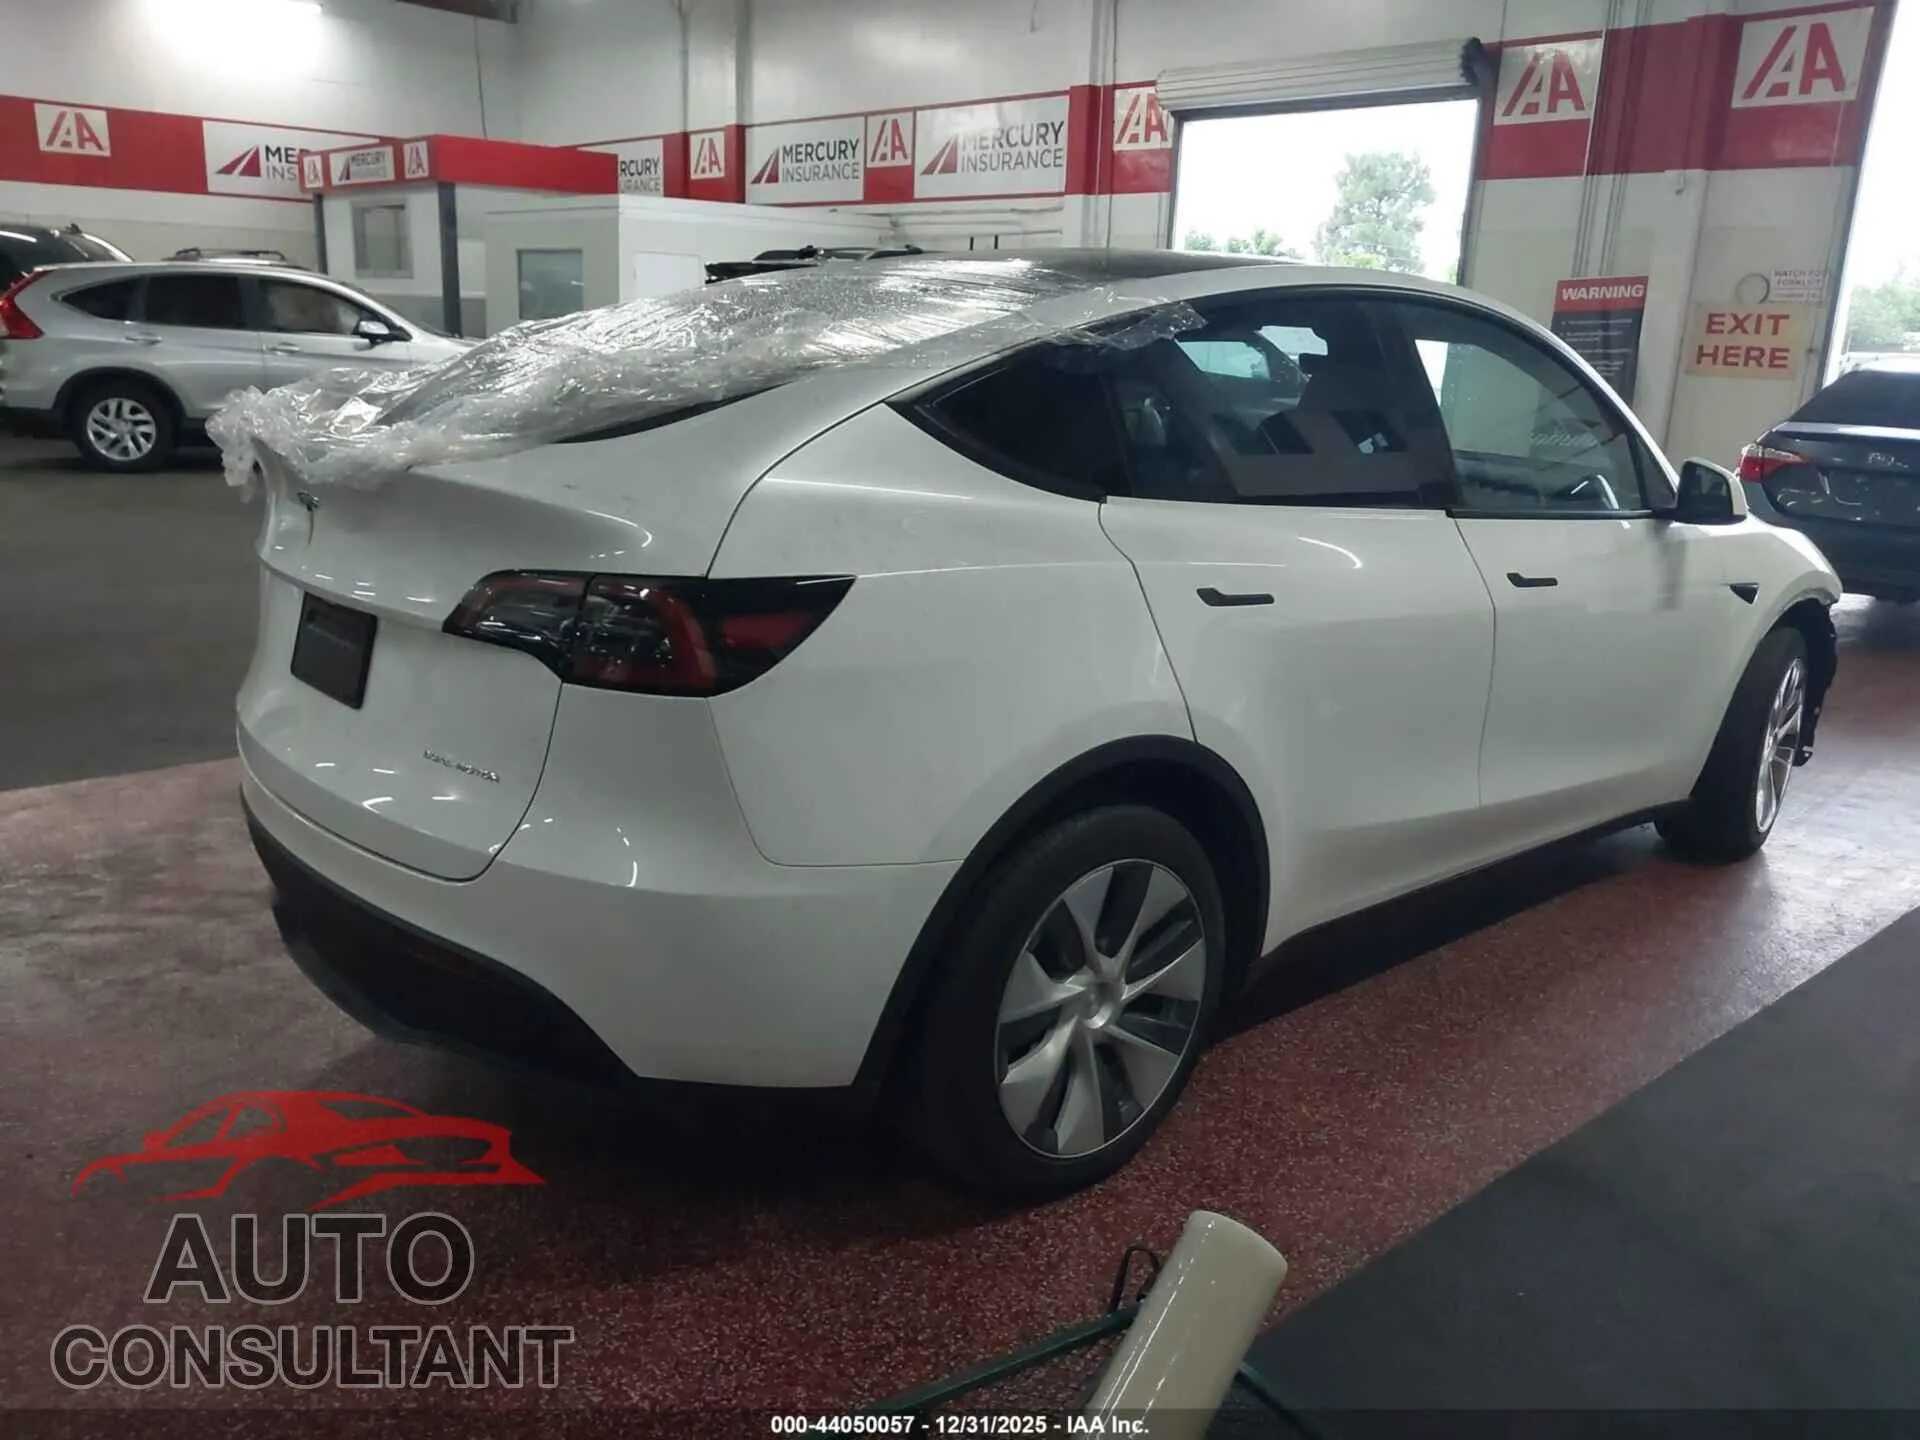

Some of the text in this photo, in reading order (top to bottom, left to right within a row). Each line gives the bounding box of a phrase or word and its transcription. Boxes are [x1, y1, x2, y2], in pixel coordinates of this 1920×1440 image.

[963, 120, 1065, 152] MERCURY
[782, 138, 860, 164] MERCURY
[961, 147, 1064, 174] INSURANCE
[781, 162, 860, 183] INSURANCE
[1562, 284, 1645, 301] WARNING
[1705, 312, 1790, 336] EXIT
[1696, 344, 1790, 369] HERE
